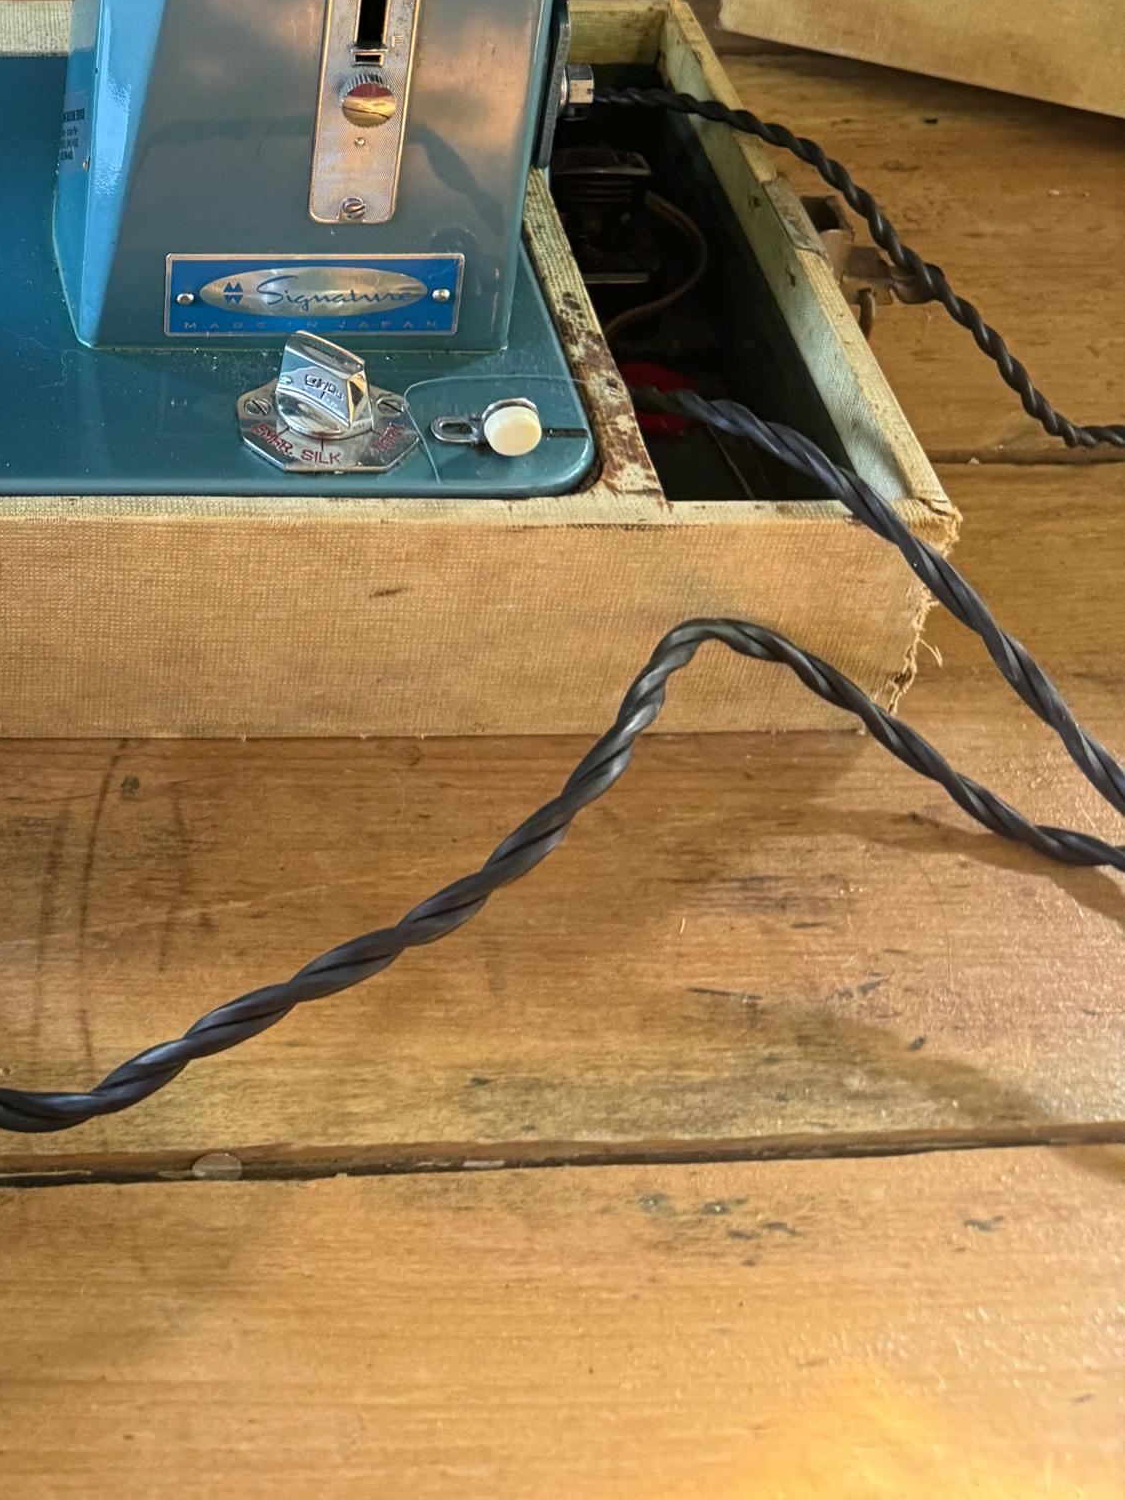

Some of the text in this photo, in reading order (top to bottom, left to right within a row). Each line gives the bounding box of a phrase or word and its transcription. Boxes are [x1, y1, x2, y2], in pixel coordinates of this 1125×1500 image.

[256, 274, 412, 312] Signature
[183, 321, 268, 330] MADE
[338, 320, 437, 330] JAPAN
[300, 449, 343, 465] SILK
